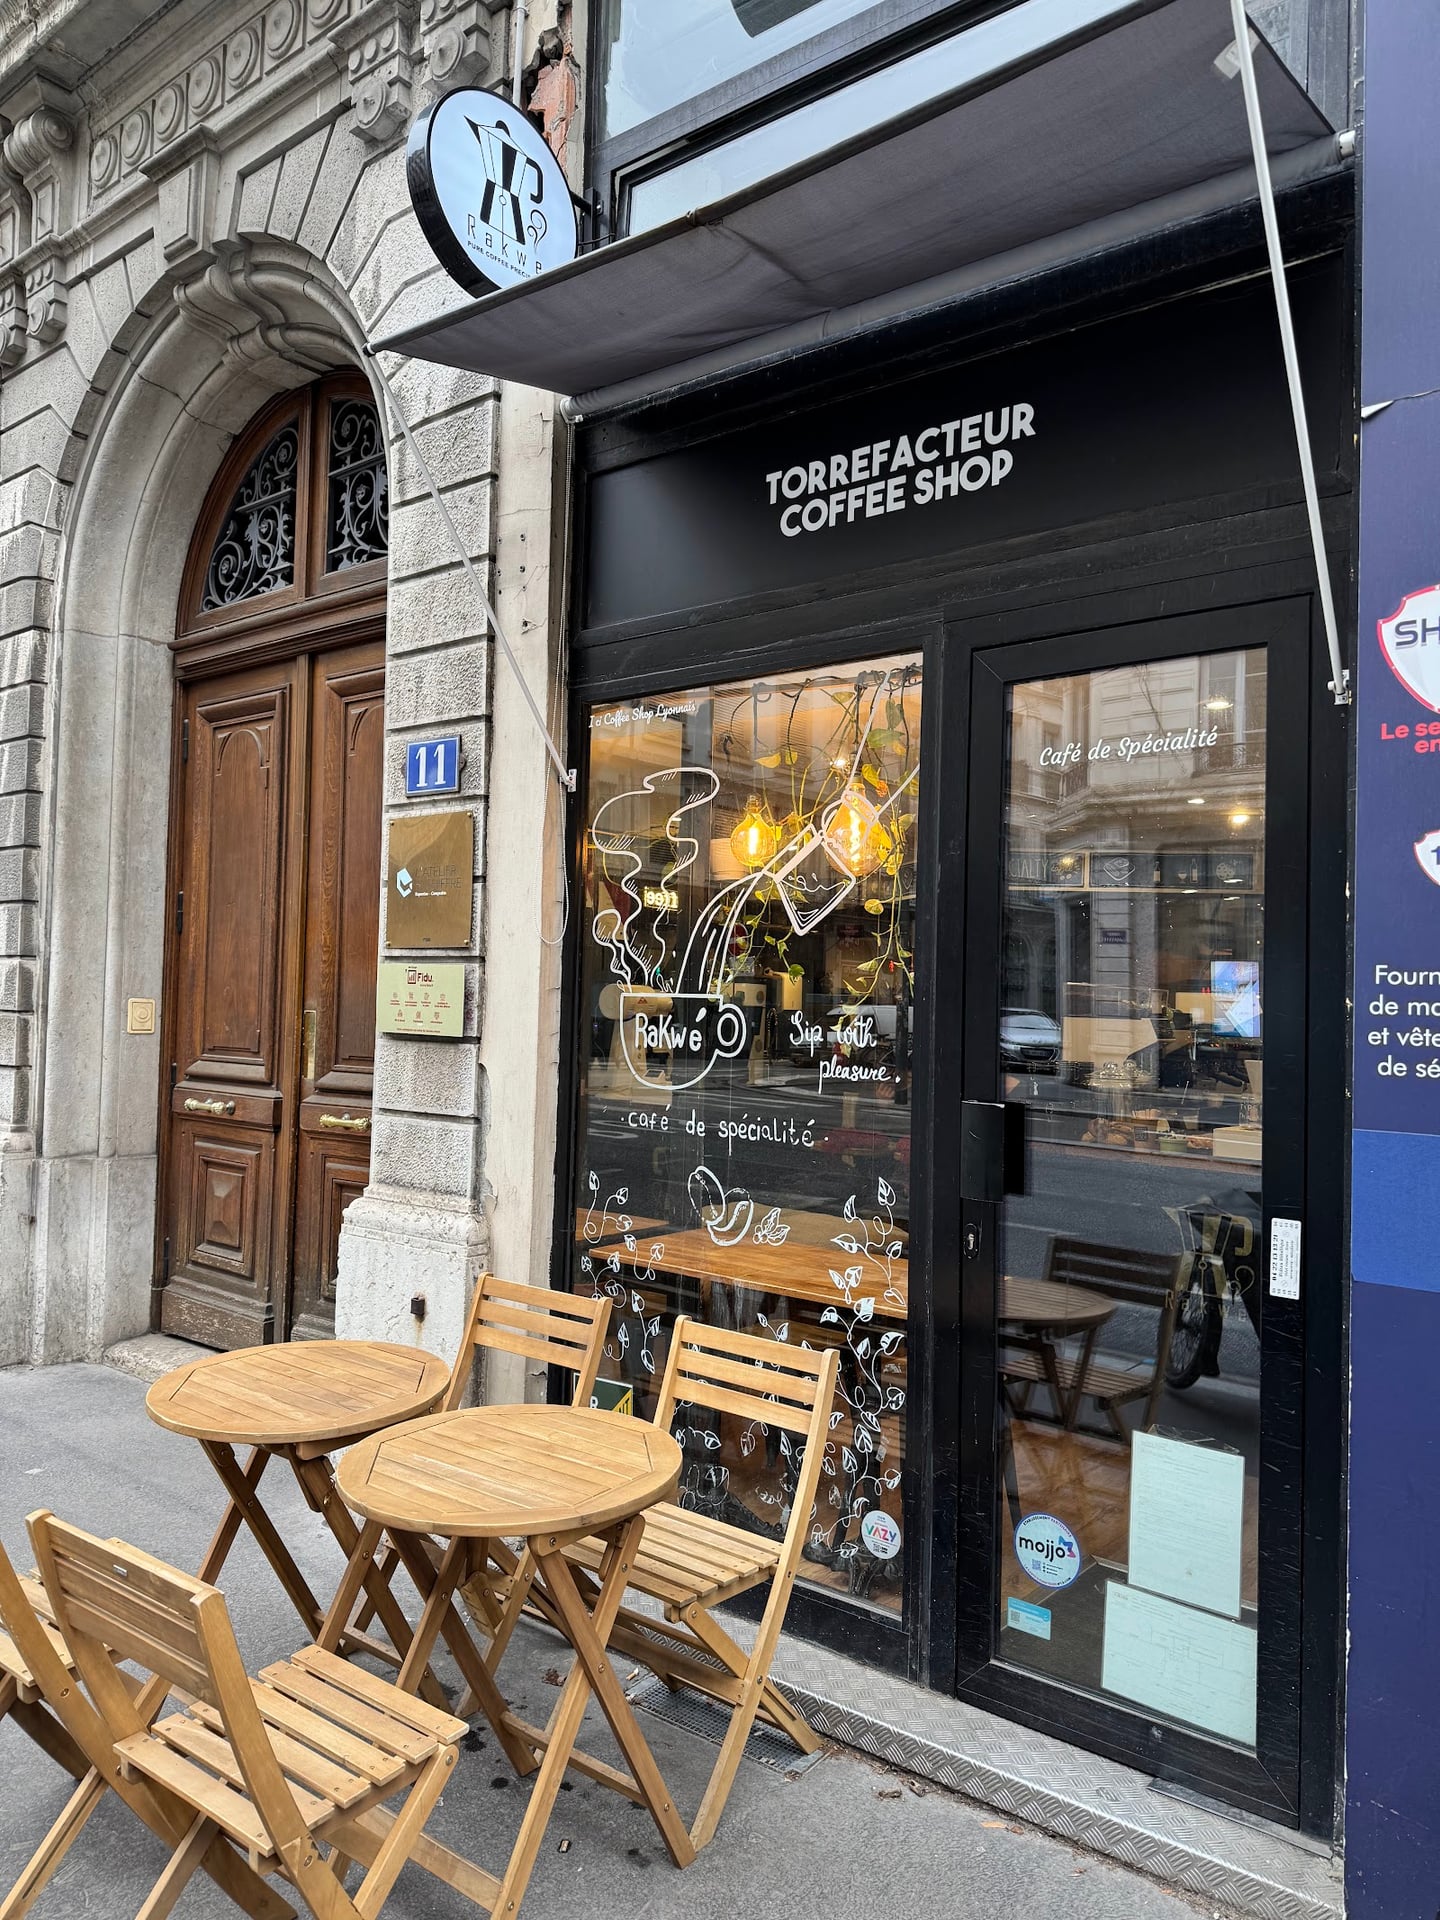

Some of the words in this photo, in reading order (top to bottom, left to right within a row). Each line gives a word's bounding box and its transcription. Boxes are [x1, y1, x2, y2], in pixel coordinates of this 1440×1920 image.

[467, 240, 485, 255] PURE
[485, 251, 509, 268] COFFEE
[468, 213, 542, 275] Rakwe
[766, 402, 1036, 504] TORREFACTEUR
[780, 475, 907, 537] COFFEE
[913, 449, 1014, 505] SHOP
[604, 709, 630, 727] Coffee
[632, 705, 654, 724] Shop
[655, 700, 696, 721] Lyonnais
[1381, 723, 1409, 740] Le
[1039, 742, 1081, 766] Café
[1088, 739, 1111, 760] de
[1117, 725, 1218, 762] Spécialité
[415, 744, 446, 787] 11
[1375, 965, 1440, 985] Fourn
[1369, 994, 1399, 1015] de
[789, 1010, 823, 1057] Sip
[836, 1014, 877, 1047] with
[1368, 1027, 1390, 1045] et
[1378, 1055, 1407, 1076] de
[686, 1109, 706, 1137] de
[865, 1523, 897, 1542] VAZY
[1019, 1536, 1065, 1562] mojjo
